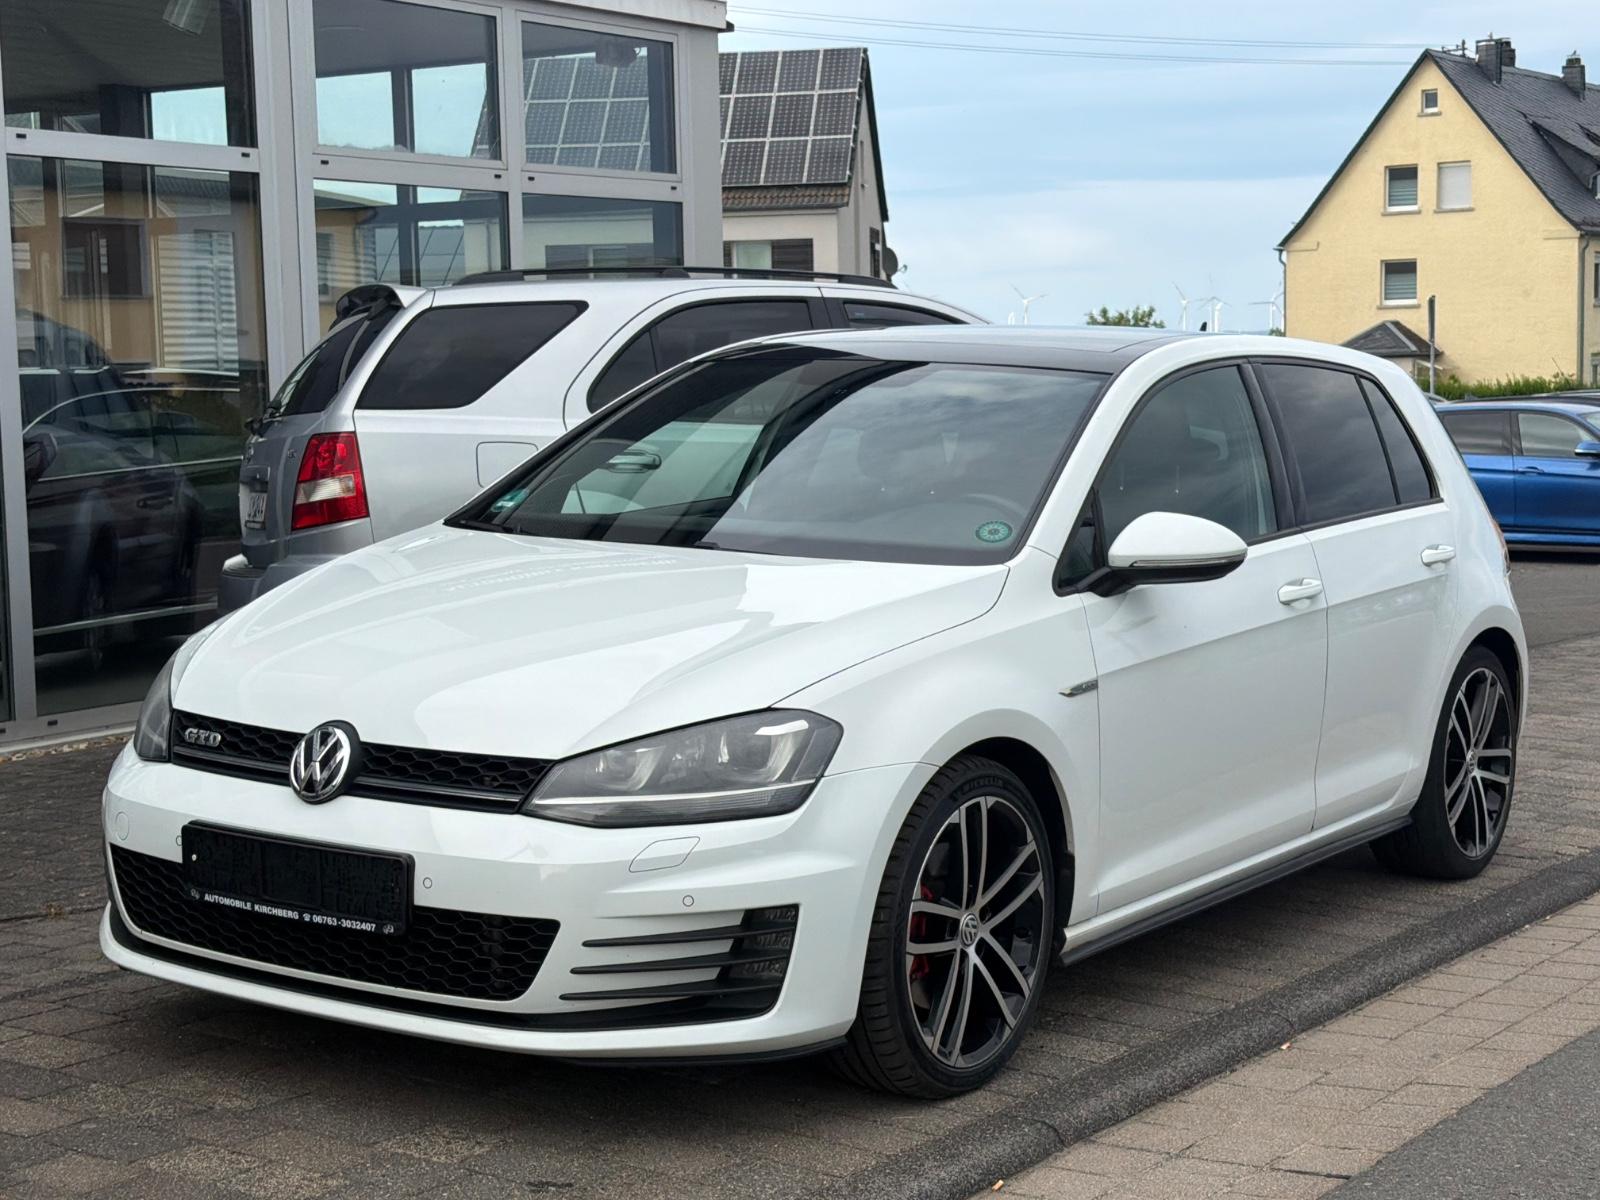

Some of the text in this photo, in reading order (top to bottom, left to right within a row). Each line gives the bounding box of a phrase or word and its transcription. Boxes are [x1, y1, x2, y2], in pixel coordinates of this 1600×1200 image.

[185, 727, 222, 747] GTD
[204, 893, 252, 910] AUTOMOBILE
[254, 904, 299, 919] KIRCHBERG
